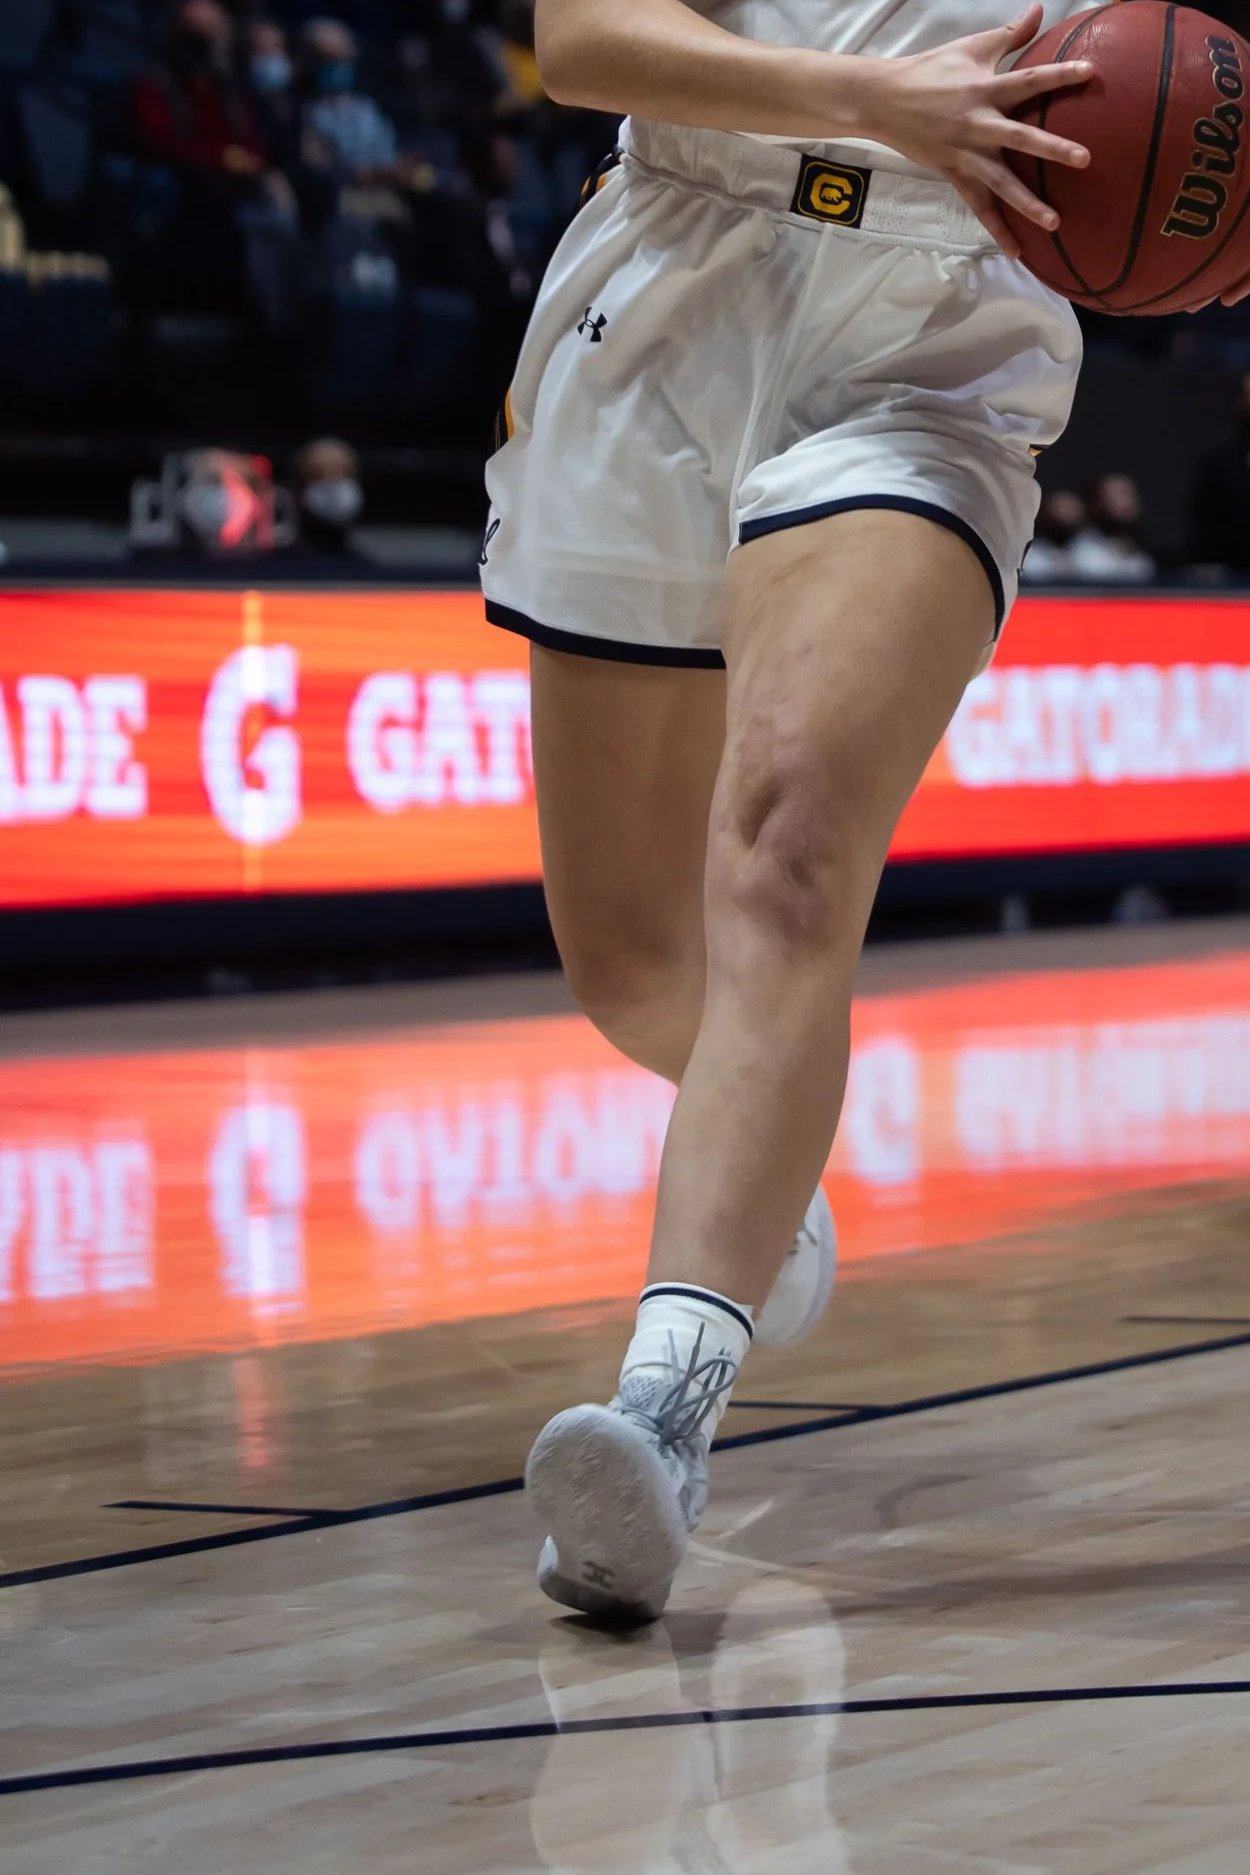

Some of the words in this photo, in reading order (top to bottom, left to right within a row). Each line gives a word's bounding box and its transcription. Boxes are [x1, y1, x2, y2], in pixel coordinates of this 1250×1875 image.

[1160, 35, 1244, 240] Wilson
[202, 642, 302, 847] G
[346, 670, 534, 817] GAT
